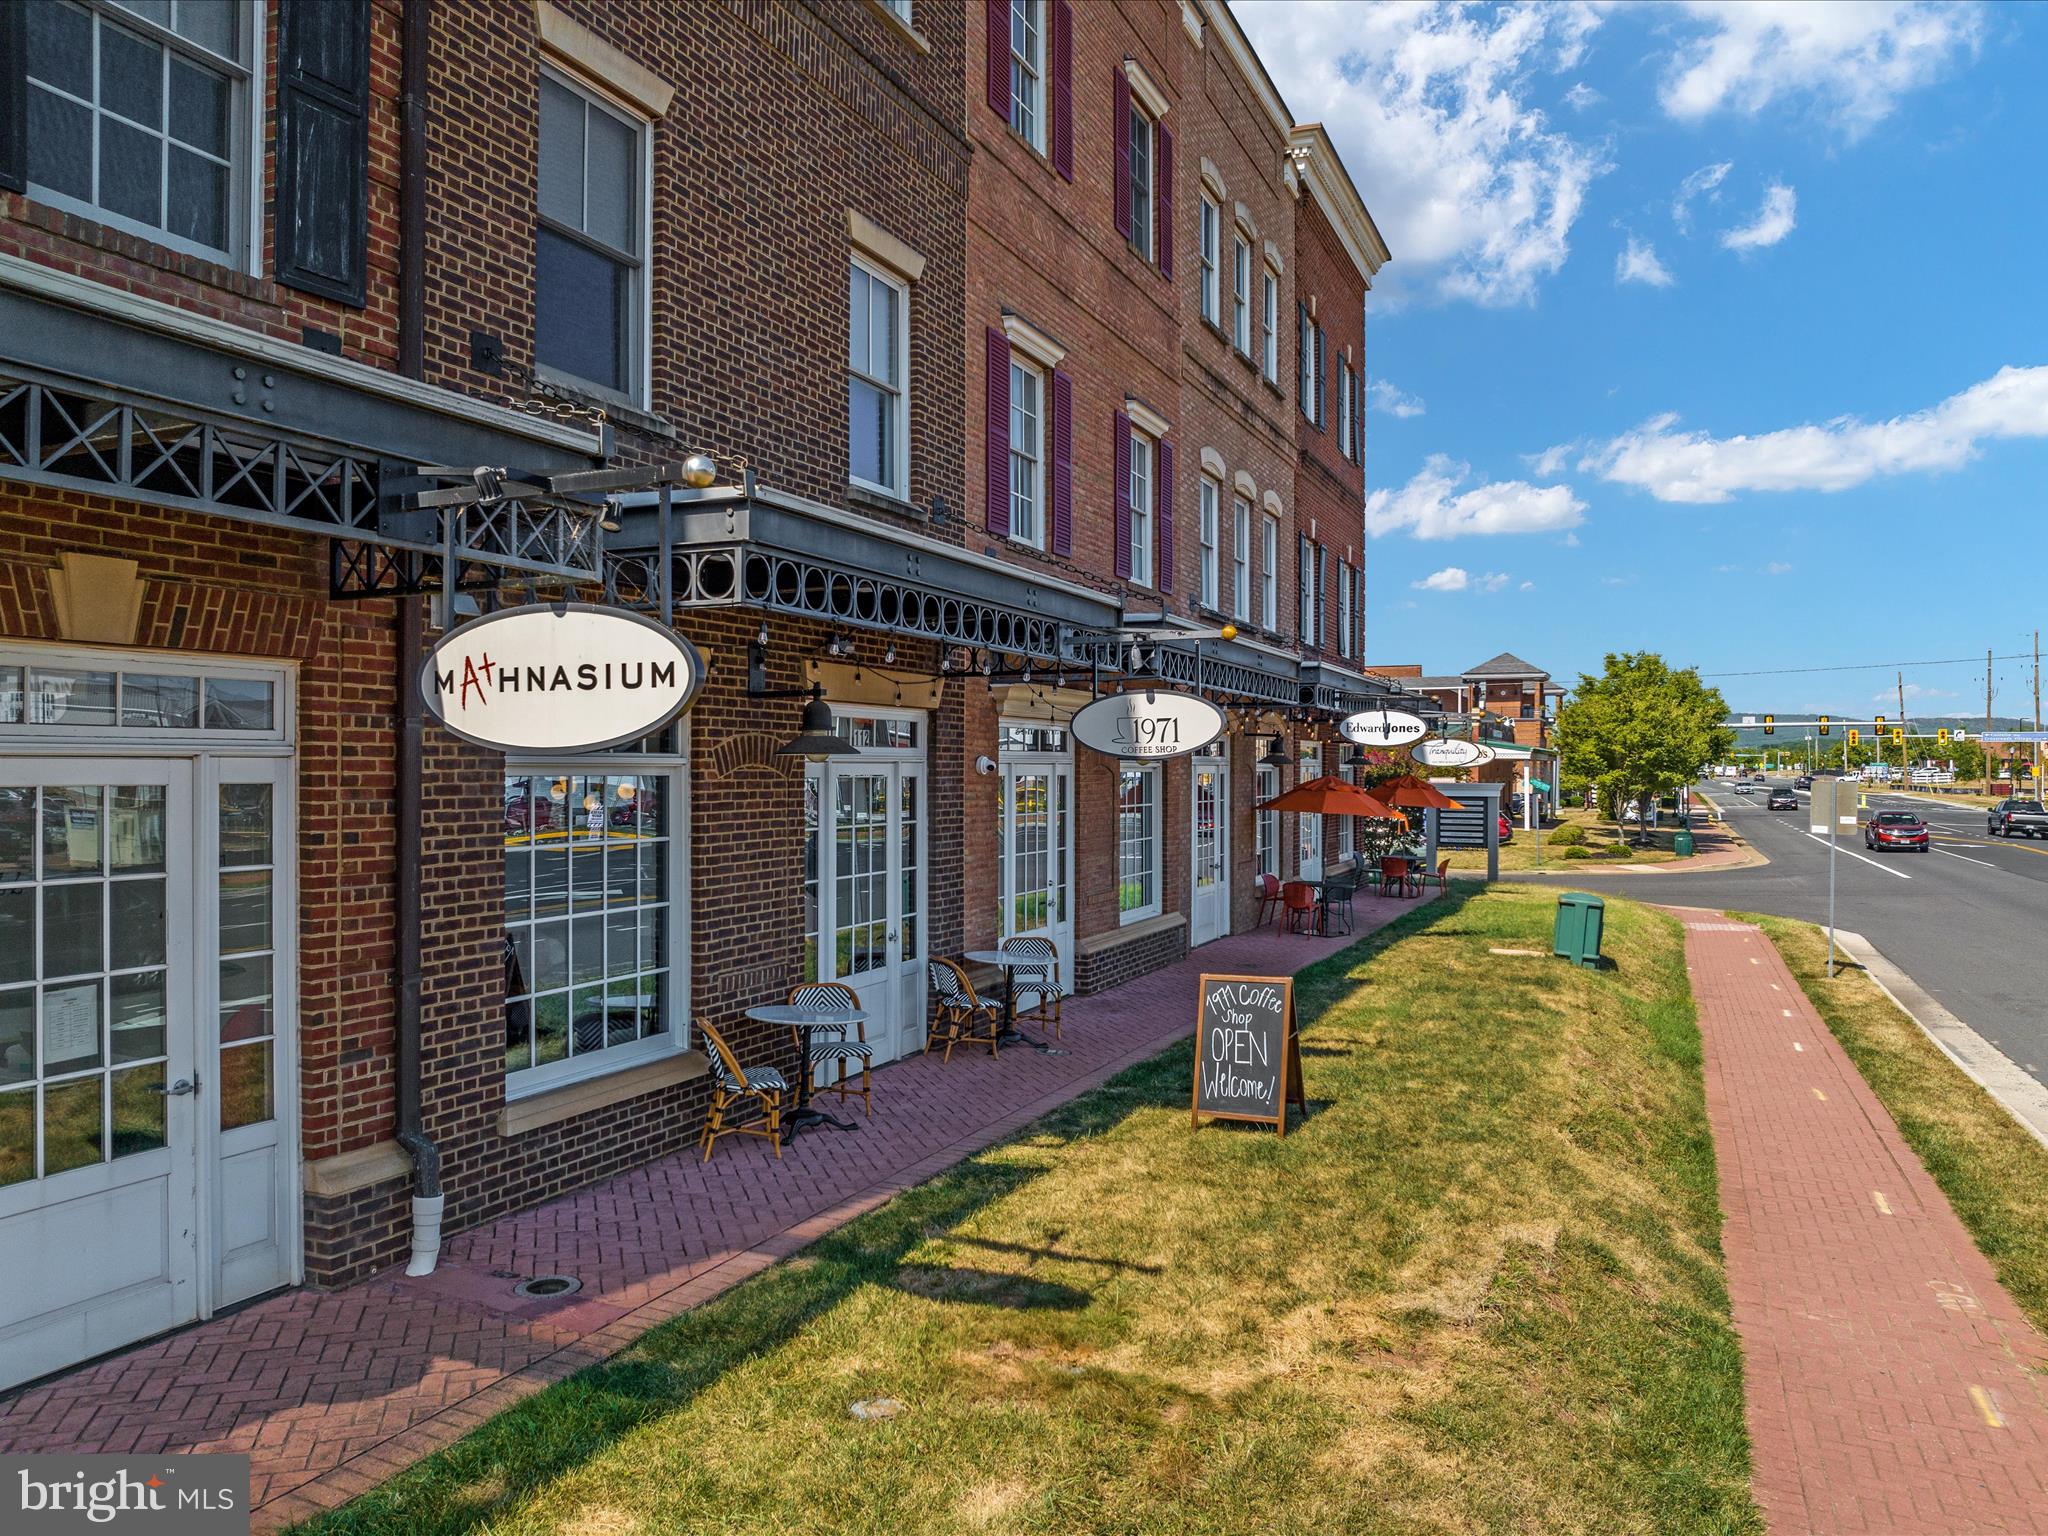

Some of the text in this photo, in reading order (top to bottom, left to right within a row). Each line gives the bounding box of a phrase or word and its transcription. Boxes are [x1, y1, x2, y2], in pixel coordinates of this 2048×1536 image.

[854, 730, 869, 746] 112
[1133, 716, 1180, 744] 1971
[1121, 745, 1178, 754] COFFEE SHOP
[1206, 984, 1282, 1015] 1971 Coffee
[1221, 1008, 1253, 1031] Shop
[1212, 1027, 1268, 1067] OPEN
[1201, 1061, 1276, 1105] Welcome!
